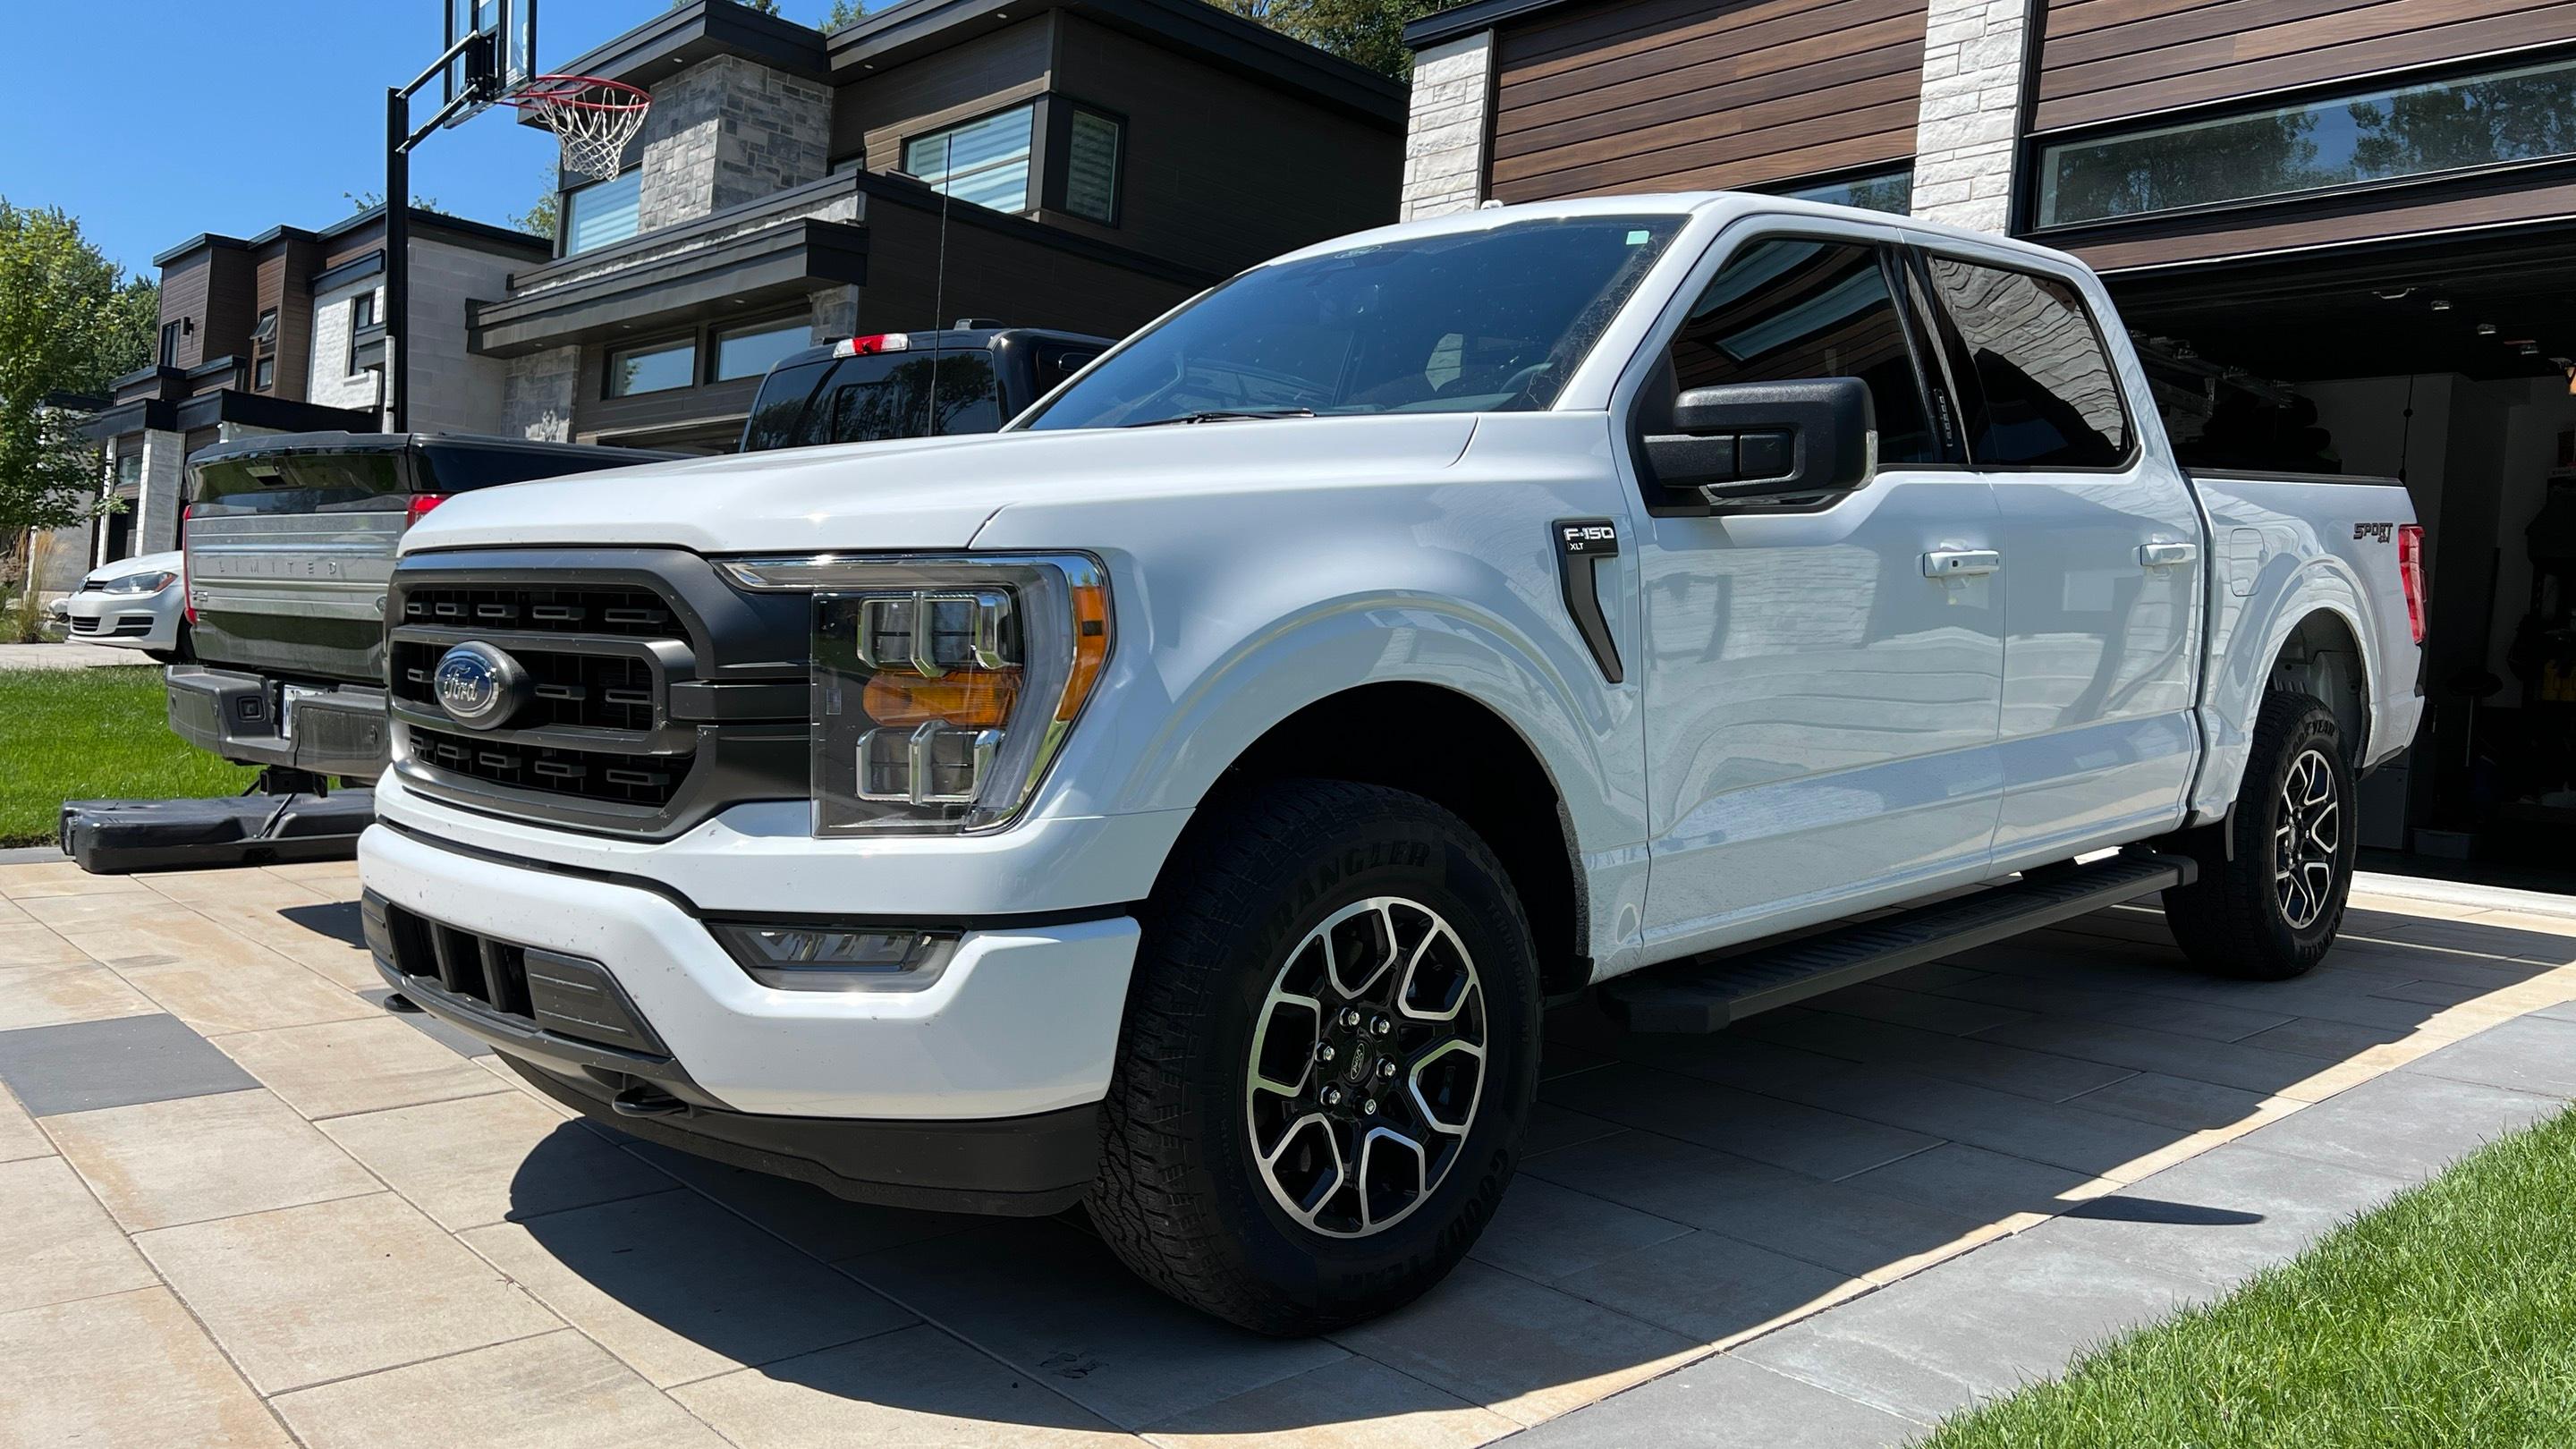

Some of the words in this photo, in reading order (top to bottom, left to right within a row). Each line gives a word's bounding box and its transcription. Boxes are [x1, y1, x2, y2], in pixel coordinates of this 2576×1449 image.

[1563, 526, 1614, 540] F-150
[2353, 522, 2394, 539] SPORT
[1570, 542, 1584, 551] XLT
[219, 561, 337, 575] LIMITED
[444, 665, 479, 702] Ford
[1253, 839, 1431, 962] WRANGLER
